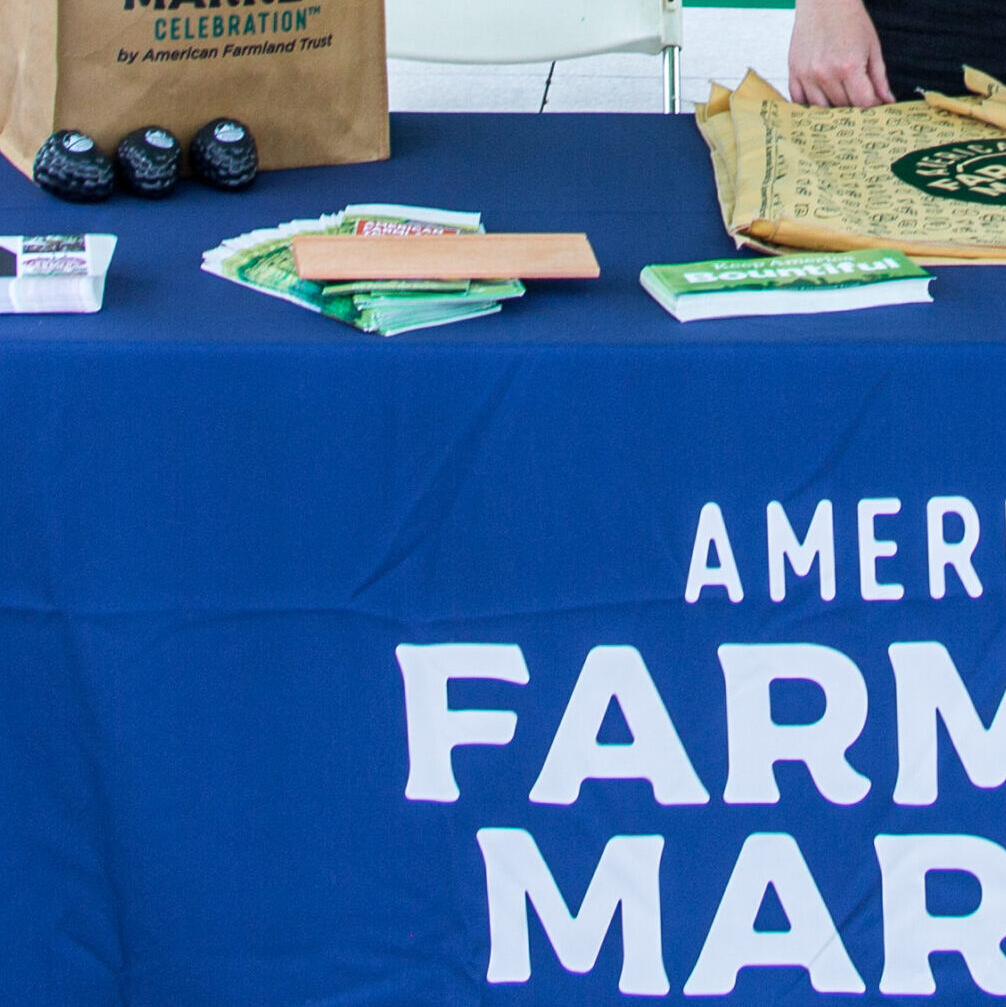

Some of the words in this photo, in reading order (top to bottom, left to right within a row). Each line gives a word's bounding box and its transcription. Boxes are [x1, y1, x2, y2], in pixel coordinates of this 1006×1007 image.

[117, 48, 139, 65] by
[142, 45, 218, 62] American
[222, 37, 296, 58] Farmland
[300, 33, 333, 50] Trust
[684, 257, 900, 284] Bountiful
